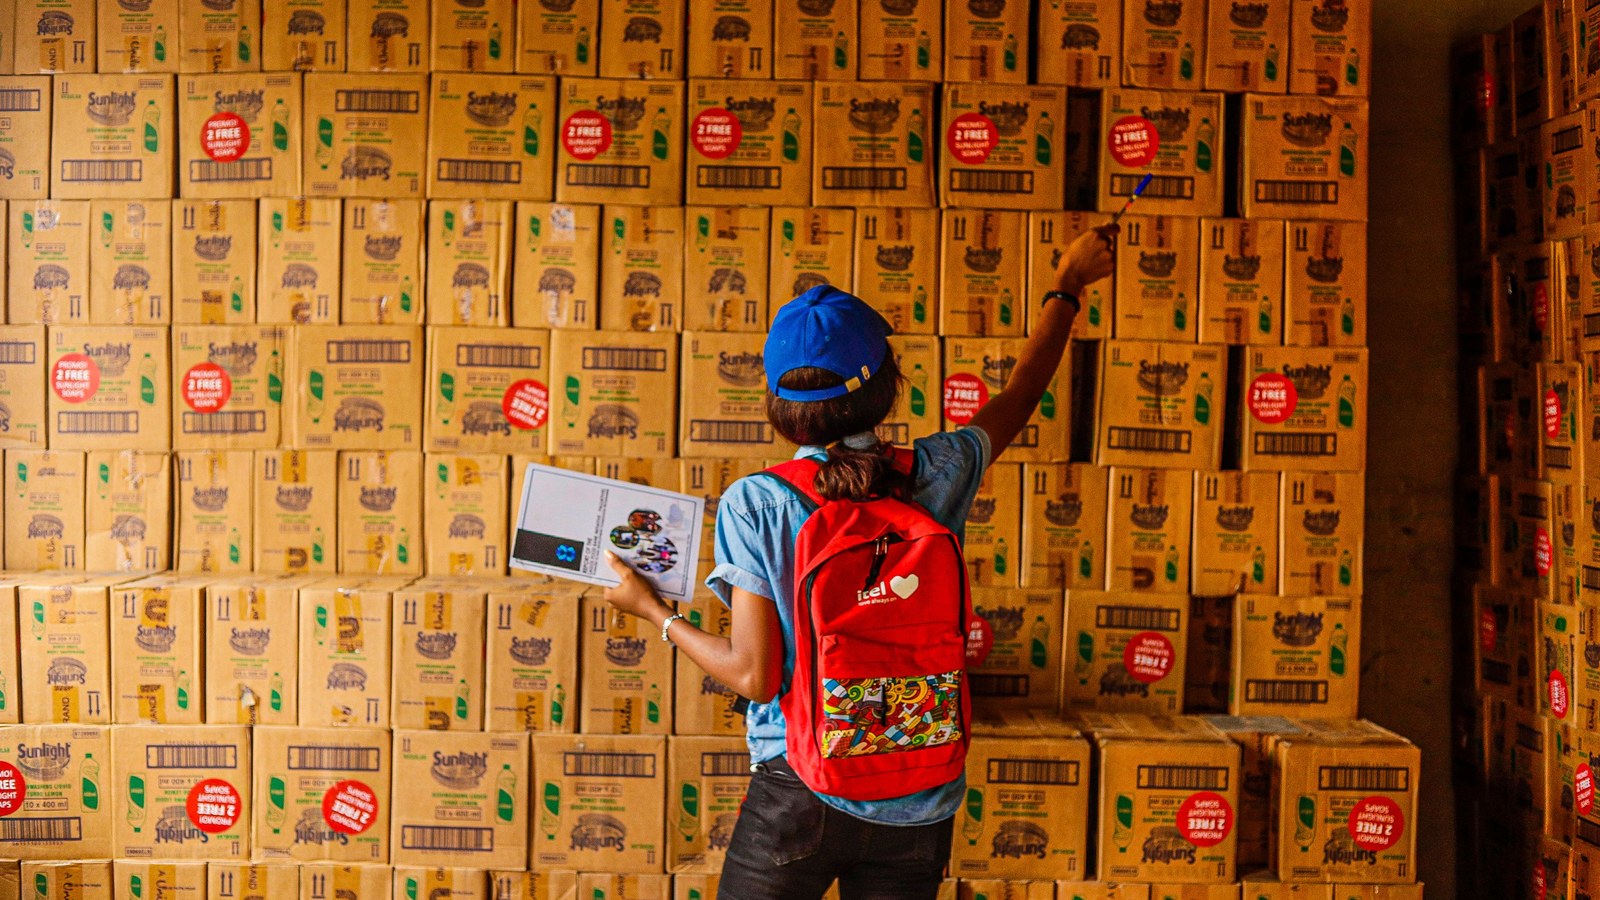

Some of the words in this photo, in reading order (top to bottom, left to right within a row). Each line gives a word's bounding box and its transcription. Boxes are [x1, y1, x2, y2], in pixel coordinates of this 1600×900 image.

[88, 91, 136, 106] Sunlight
[215, 90, 264, 105] Sunlight
[206, 129, 215, 140] 2
[215, 128, 240, 139] FREE
[567, 126, 575, 137] 2
[576, 126, 602, 137] FREE
[697, 124, 705, 135] 2
[705, 124, 732, 135] FREE
[955, 130, 963, 140] 2
[963, 130, 989, 140] FREE
[1114, 133, 1121, 144] 2
[1122, 130, 1148, 143] FREE
[341, 166, 389, 180] Sunlight
[83, 343, 131, 358] Sunlight
[208, 342, 257, 357] Sunlight
[719, 351, 764, 367] Sunligh
[983, 355, 1014, 369] Sunli
[56, 369, 63, 380] 2
[64, 369, 89, 380] FREE
[187, 379, 195, 390] 2
[196, 379, 222, 390] FREE
[953, 389, 979, 400] FREE
[1253, 389, 1260, 400] 2
[1261, 389, 1287, 400] FREE
[511, 396, 537, 416] FREE
[535, 409, 545, 420] 2
[334, 417, 383, 431] Sunlight
[463, 422, 511, 436] Sunlight
[588, 424, 637, 439] Sunlight
[857, 581, 887, 602] itel
[1133, 654, 1160, 667] FREE
[1160, 658, 1168, 669] 2
[17, 742, 71, 760] Sunlight
[433, 751, 487, 769] Sunlight
[0, 779, 16, 790] REE
[1580, 778, 1591, 789] FREE
[197, 794, 235, 804] SUNLIGHT
[336, 792, 374, 813] SUNLIGHT
[196, 803, 224, 815] FREE
[225, 804, 234, 816] 2
[332, 800, 360, 820] FREE
[198, 815, 232, 825] PROMO!
[360, 811, 370, 824] 2
[1188, 818, 1216, 829] FREE
[1217, 818, 1225, 829] 2
[1356, 821, 1383, 834] FREE
[1384, 824, 1393, 835] 2
[155, 828, 208, 843] Sunlight
[295, 828, 348, 845] Sunlight
[570, 835, 624, 851] Sunlight
[992, 842, 1046, 858] Sunlight
[1141, 847, 1196, 864] Sunlight
